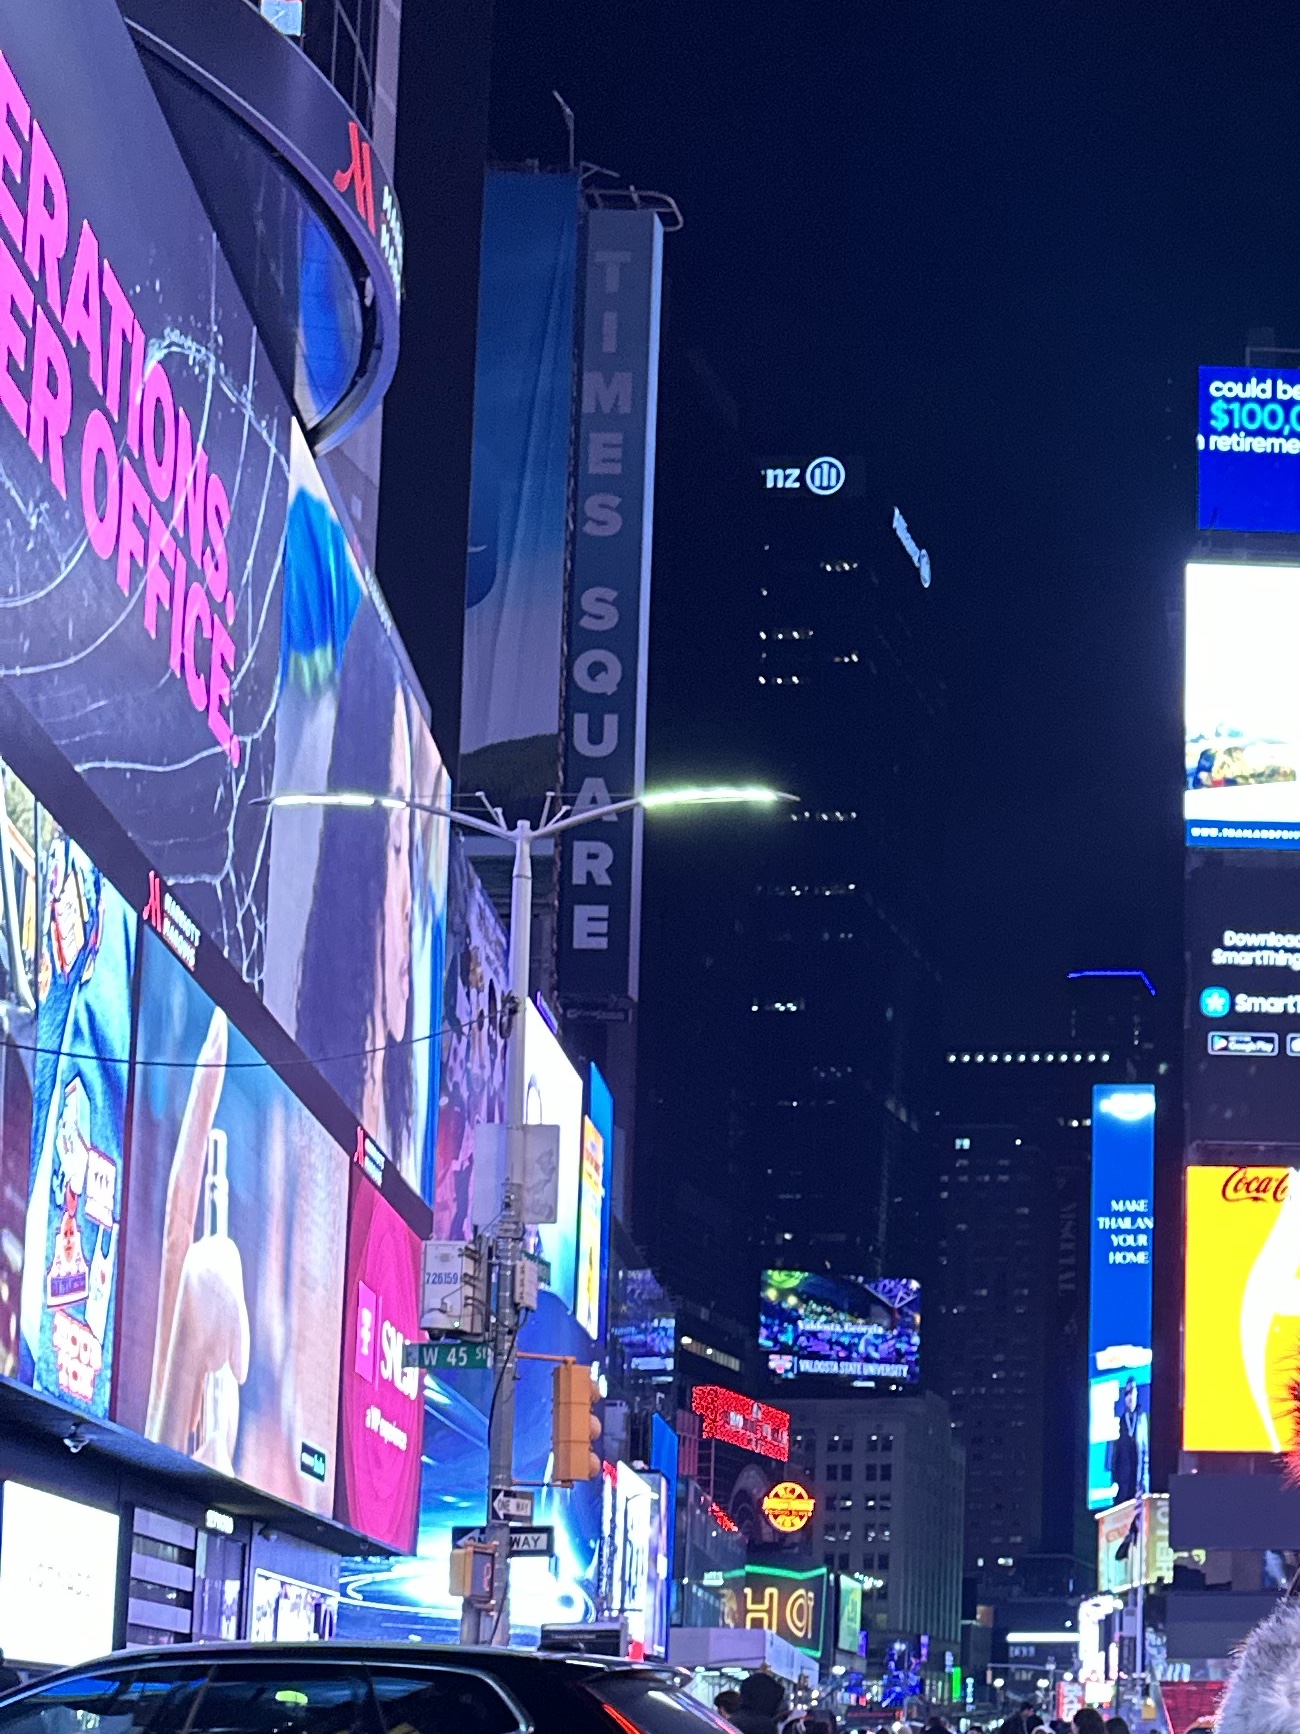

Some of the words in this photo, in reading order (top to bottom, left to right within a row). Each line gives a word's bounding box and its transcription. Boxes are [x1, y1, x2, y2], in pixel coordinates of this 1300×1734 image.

[581, 250, 634, 537] TIMES
[1209, 376, 1273, 400] could
[81, 408, 240, 767] OFFICE.
[570, 584, 624, 951] SQUARE
[1111, 1199, 1149, 1213] MAKE
[1110, 1234, 1148, 1248] YOUR
[1108, 1251, 1150, 1265] HOME
[423, 1347, 439, 1366] W
[446, 1347, 468, 1366] 45
